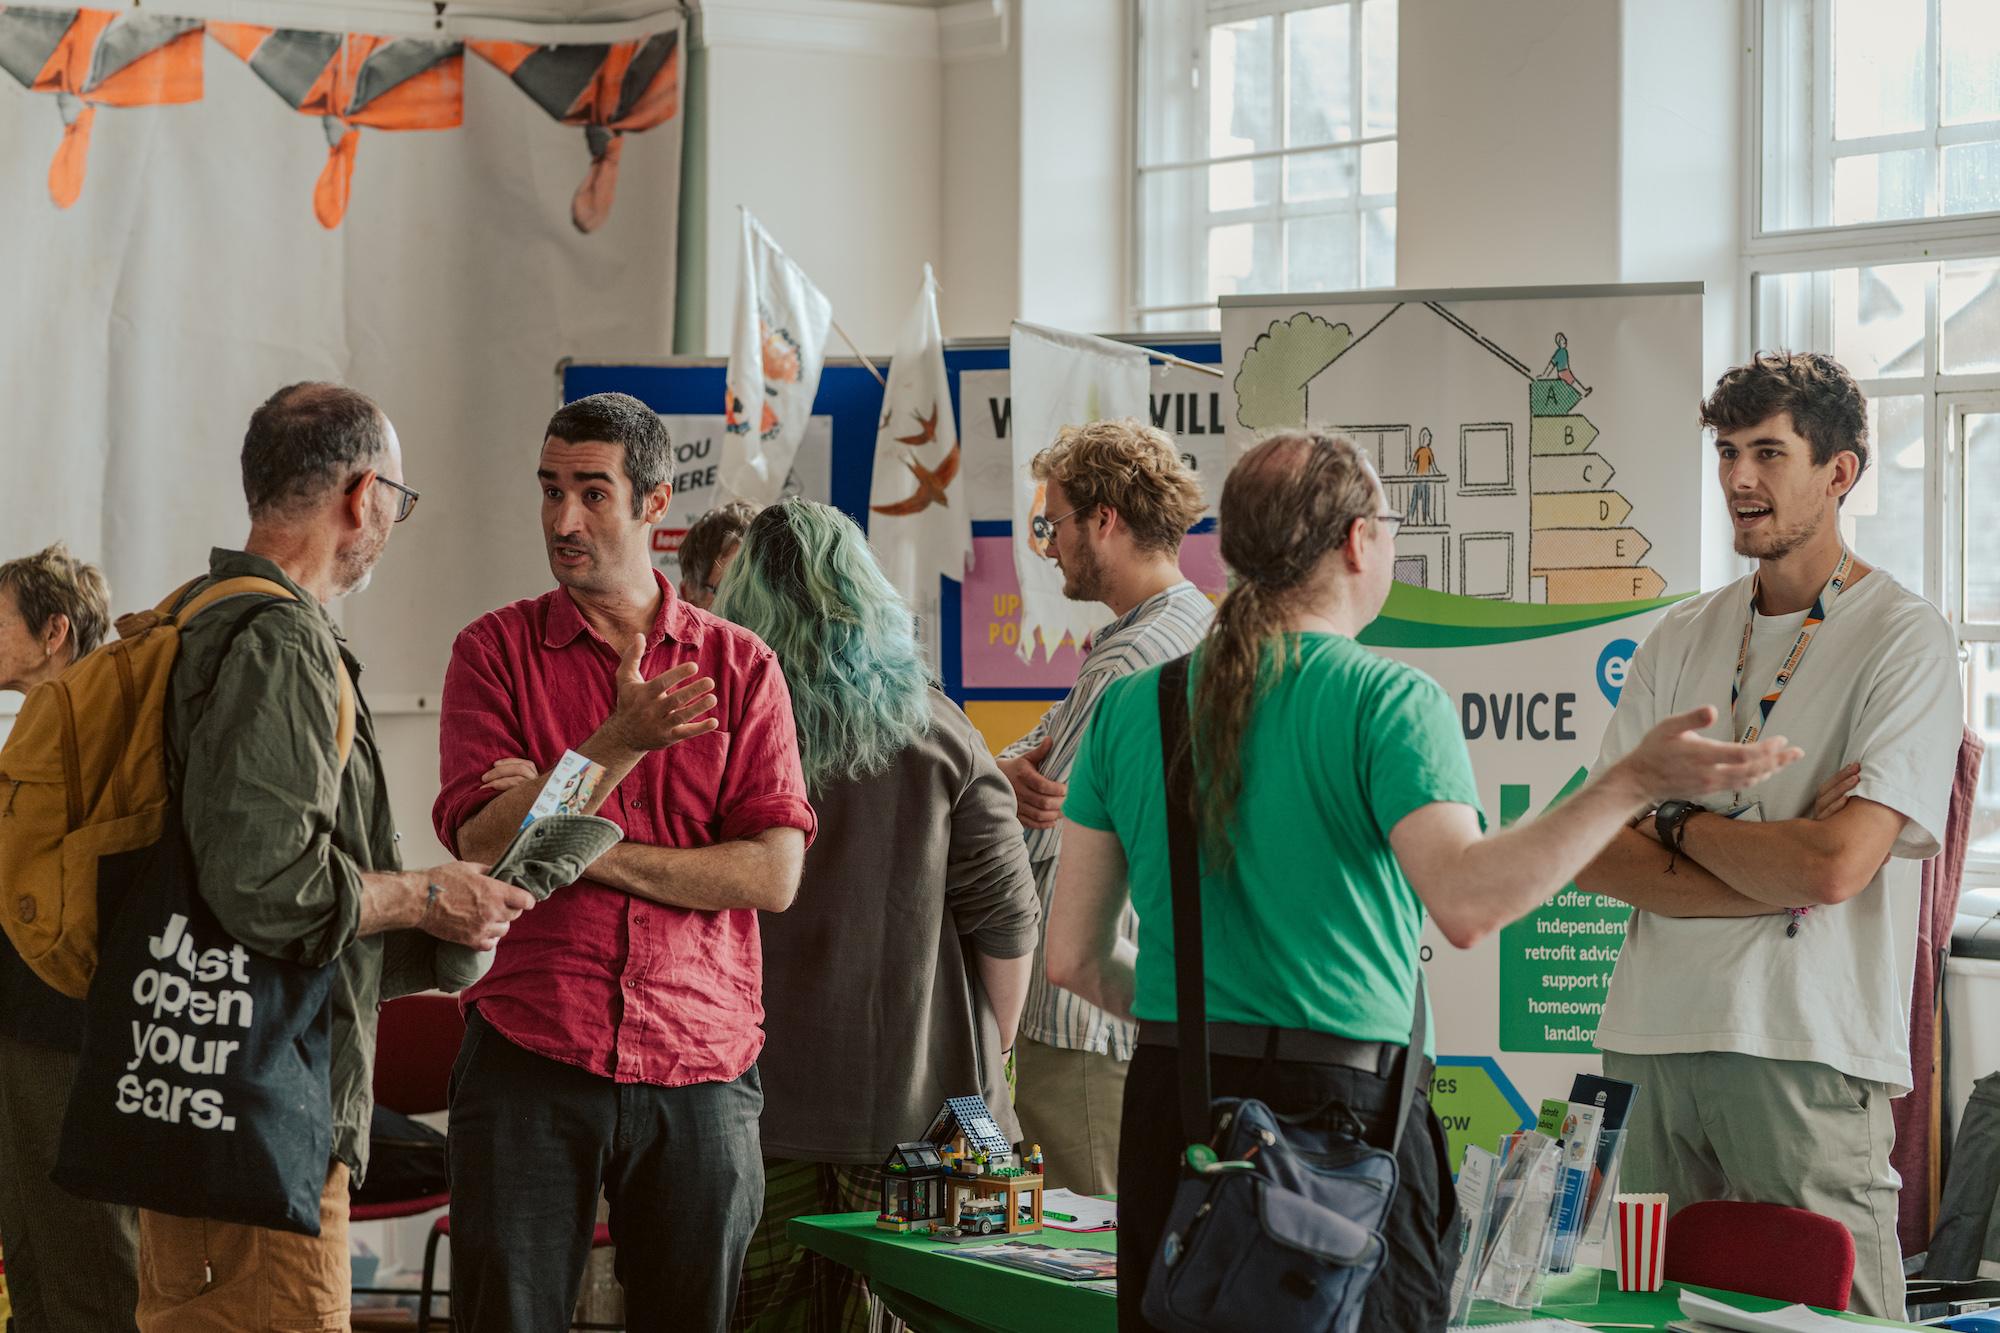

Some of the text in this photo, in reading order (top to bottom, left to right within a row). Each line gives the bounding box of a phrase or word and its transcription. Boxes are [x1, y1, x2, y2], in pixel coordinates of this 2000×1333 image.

[1546, 387, 1558, 405] A
[1150, 392, 1225, 435] WILL
[1565, 426, 1574, 445] B
[674, 437, 711, 463] OU
[1583, 465, 1592, 482] C
[1600, 500, 1609, 520] D
[1616, 539, 1625, 557] E
[1633, 578, 1643, 596] F
[1786, 633, 1811, 671] PARTNERSHIP
[1462, 692, 1576, 740] DVICE
[1557, 891, 1592, 907] offer
[1537, 918, 1628, 937] independent
[149, 913, 250, 984] Just
[1525, 945, 1619, 962] retrofit advic
[1542, 973, 1598, 991] support
[132, 968, 254, 1028] open
[1544, 1025, 1596, 1042] landlor
[127, 1020, 240, 1075] your
[115, 1073, 236, 1132] ears.
[1540, 1106, 1559, 1117] Retrofit
[1441, 1116, 1471, 1131] ow
[1538, 1119, 1553, 1129] advice
